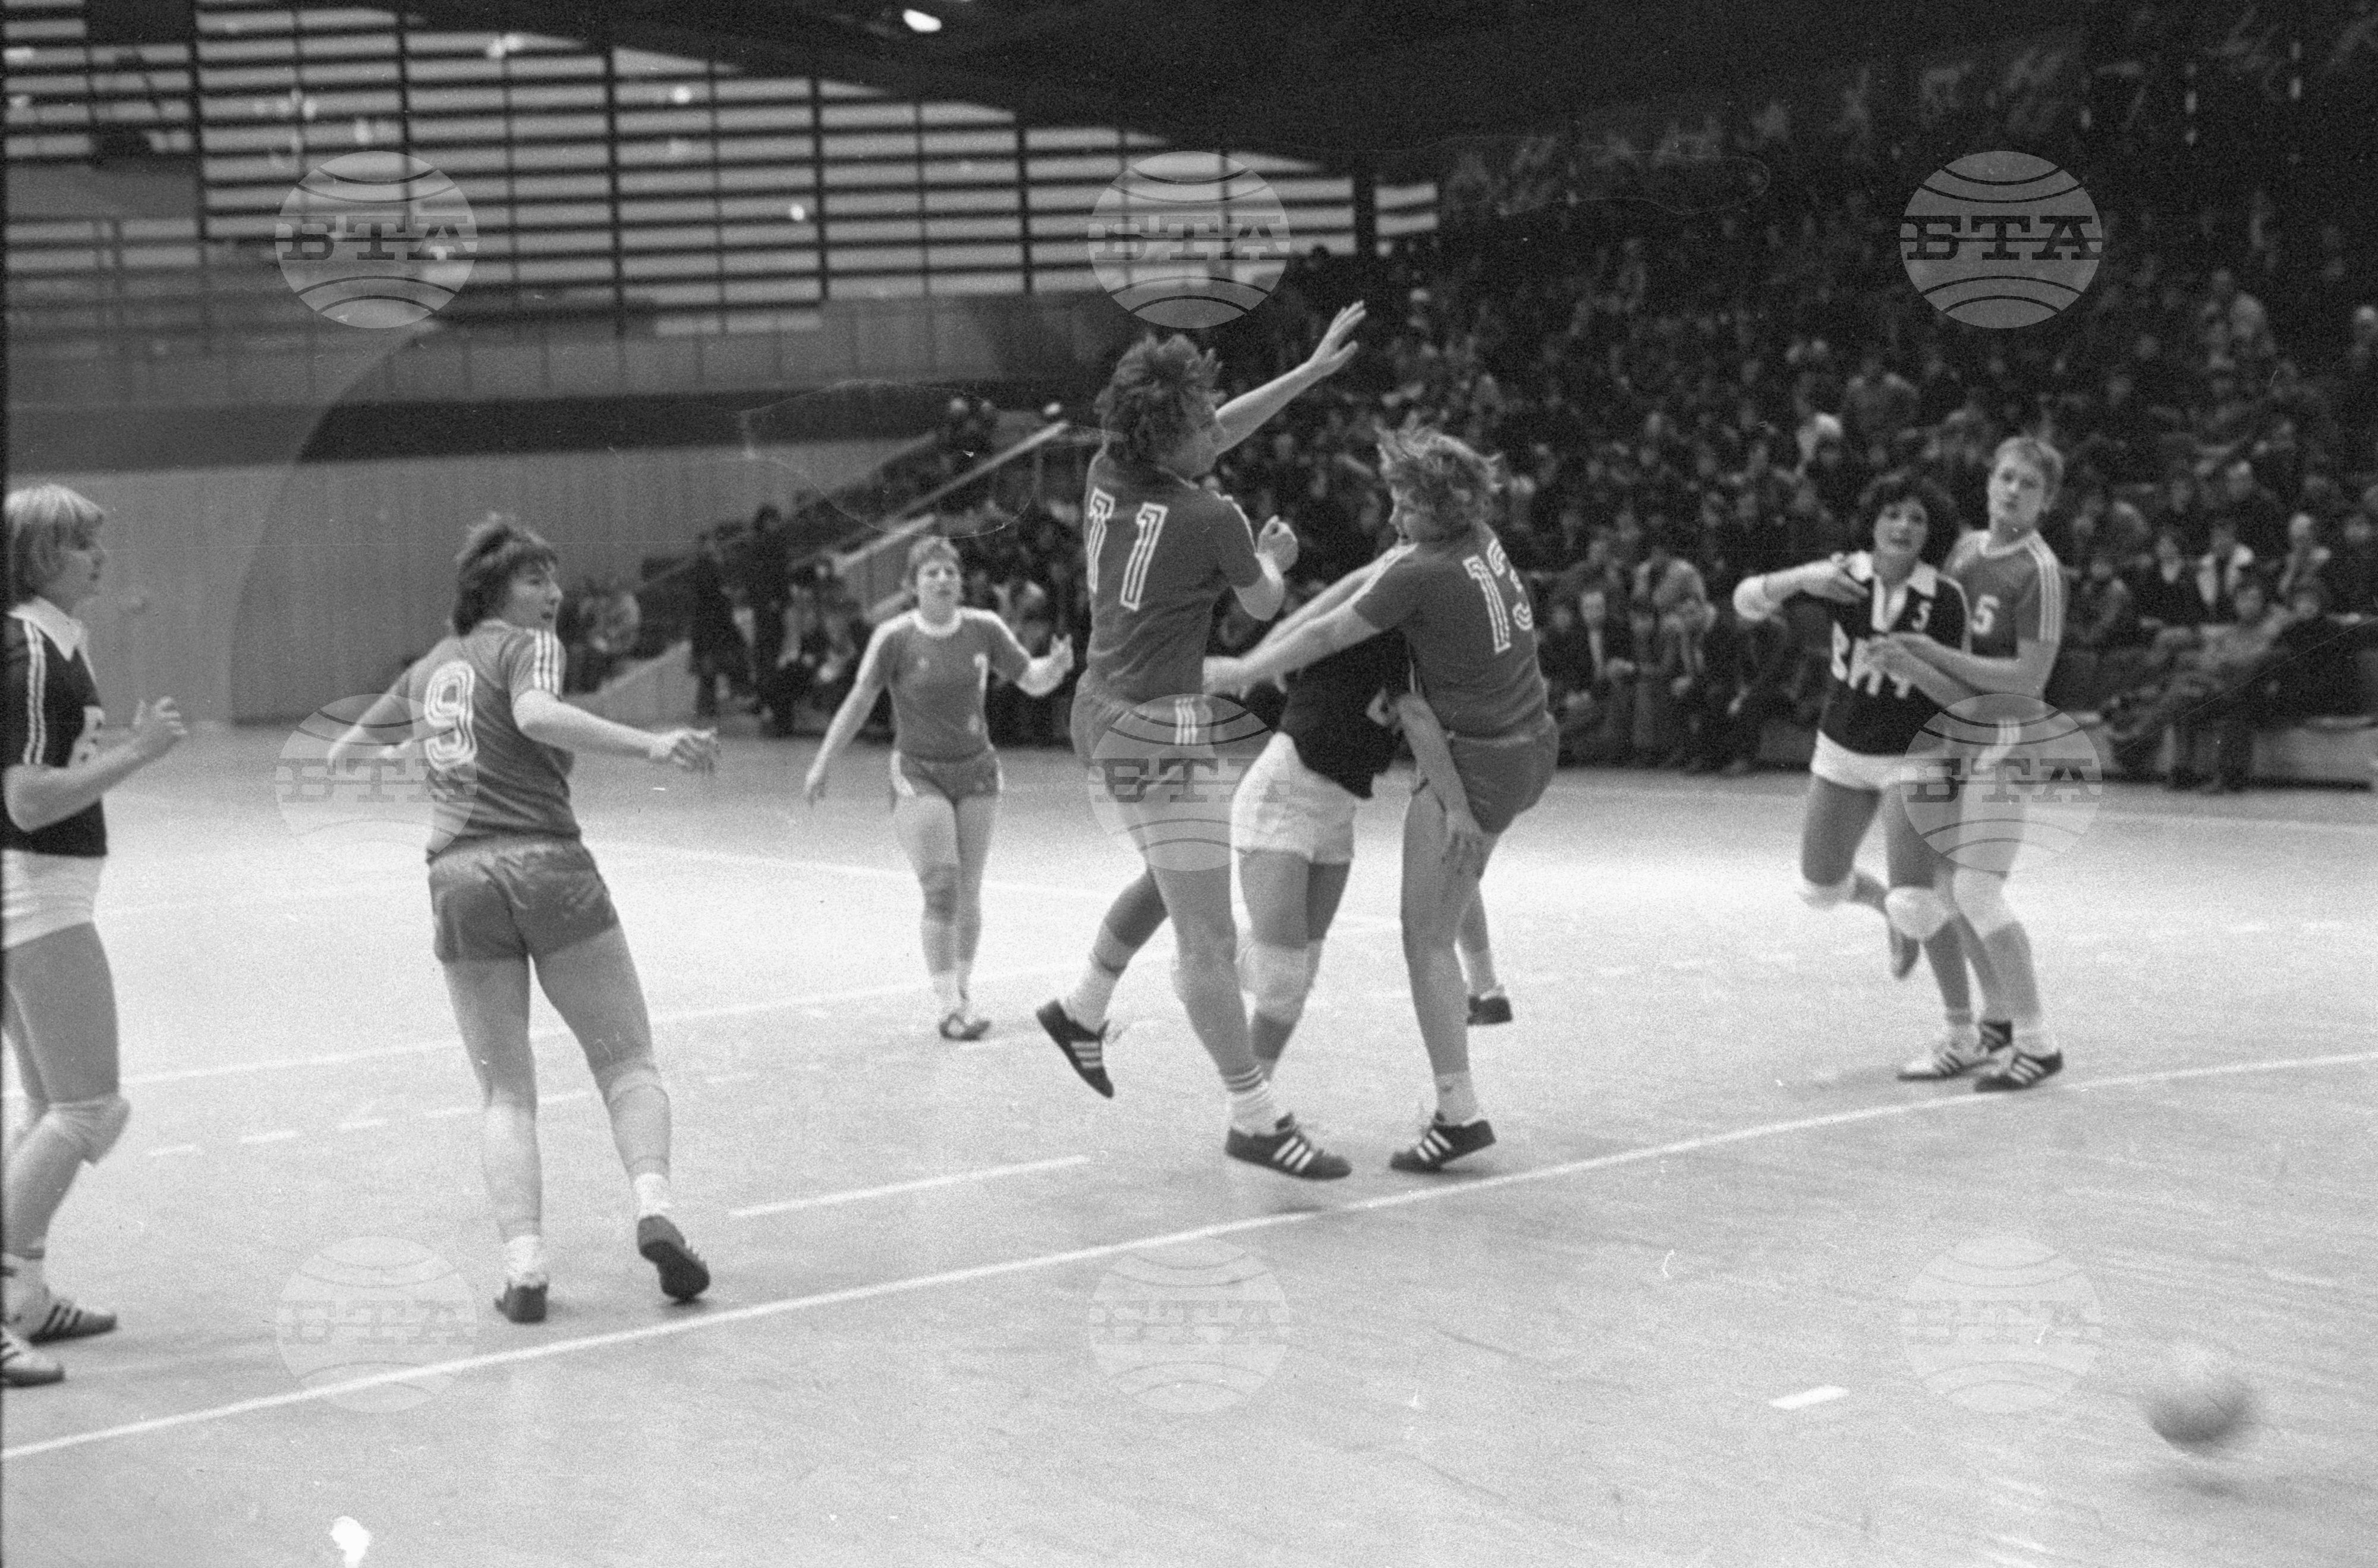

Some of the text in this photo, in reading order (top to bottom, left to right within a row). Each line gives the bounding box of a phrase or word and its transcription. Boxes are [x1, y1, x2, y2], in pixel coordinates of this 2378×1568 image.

[1087, 487, 1169, 611] 11
[1971, 595, 2000, 635] 5
[423, 660, 479, 772] 9
